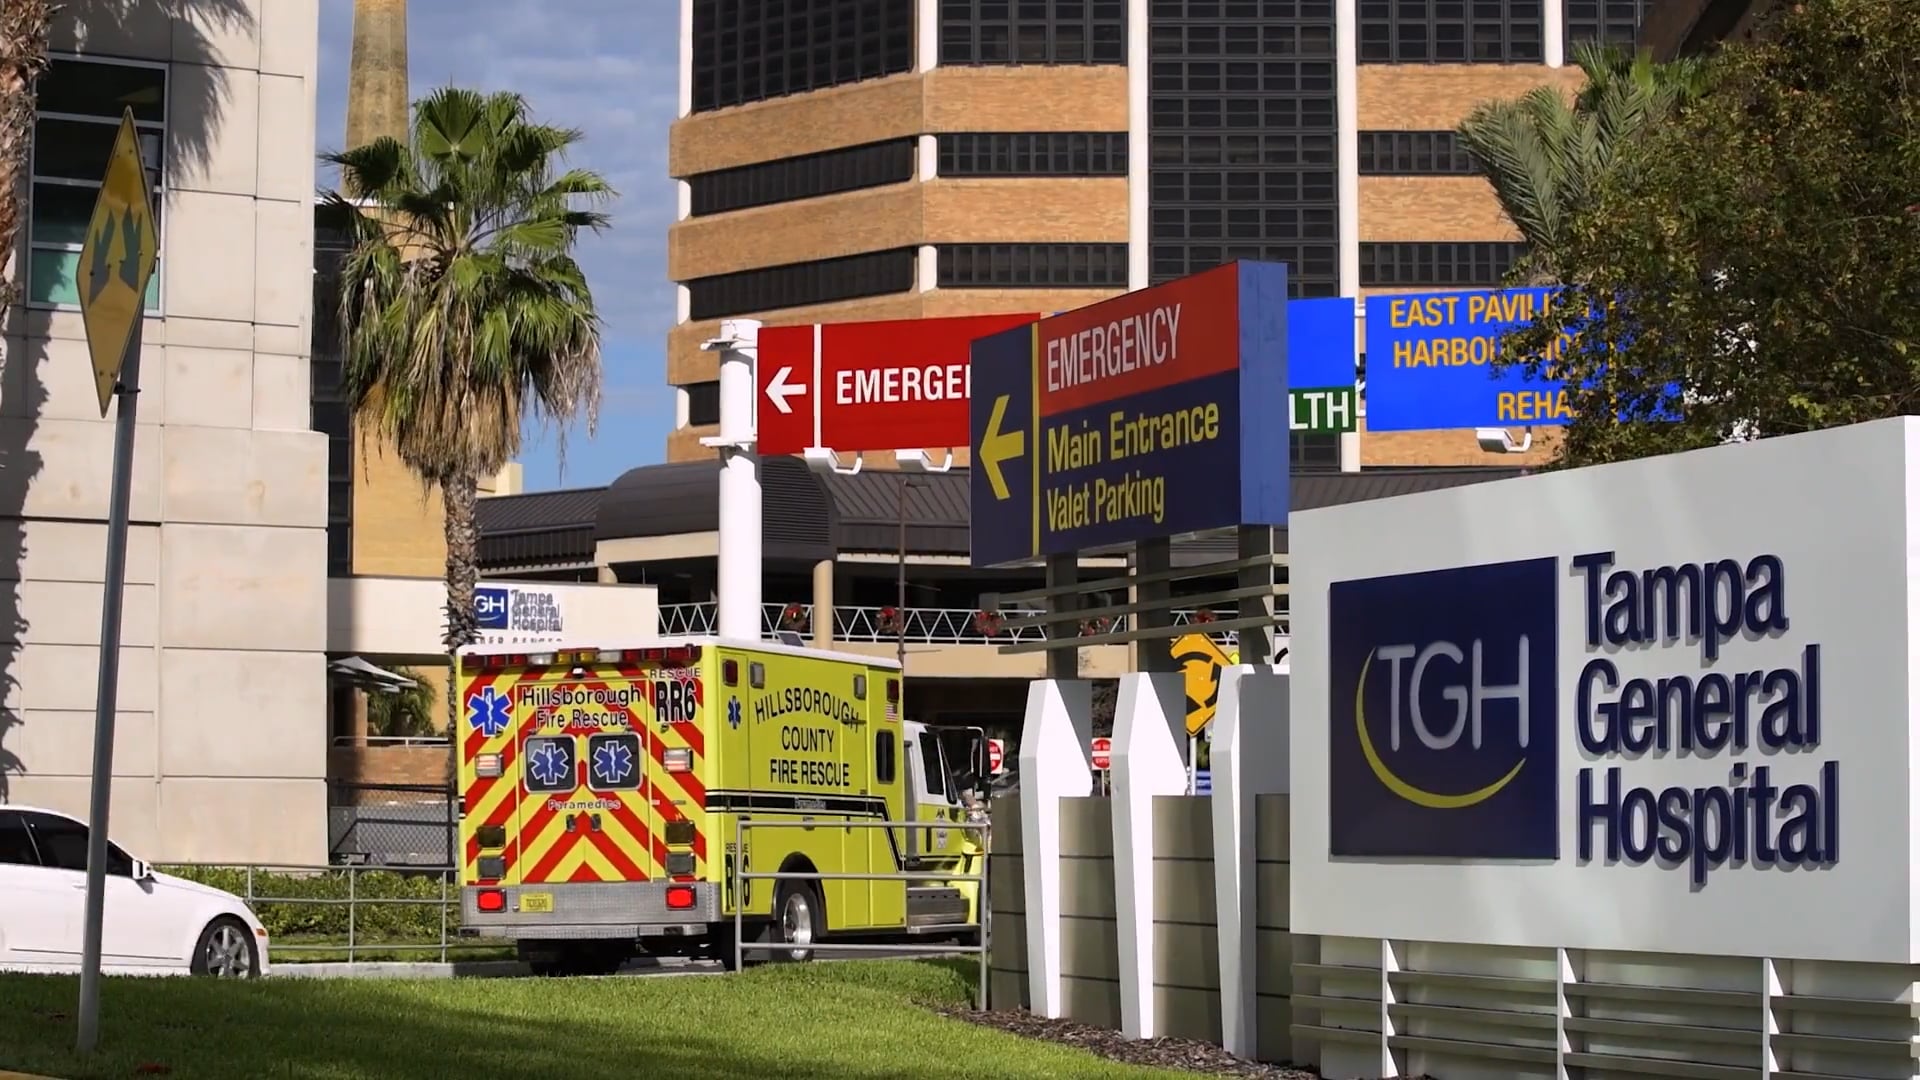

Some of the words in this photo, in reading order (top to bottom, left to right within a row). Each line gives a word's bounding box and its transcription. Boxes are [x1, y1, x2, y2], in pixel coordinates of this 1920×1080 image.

[1390, 297, 1459, 328] EAST
[1047, 303, 1183, 394] EMERGENCY
[1498, 390, 1583, 421] REHA
[1048, 417, 1102, 476] Main
[1109, 402, 1221, 459] Entrance
[1048, 484, 1091, 533] Valet
[1094, 472, 1165, 526] Parking
[1573, 551, 1791, 662] Tampa
[649, 667, 702, 679] RESCUE
[1377, 633, 1531, 753] TGH
[522, 685, 641, 708] Hillsborough
[535, 709, 566, 729] Fire
[571, 708, 629, 728] Rescue
[655, 679, 697, 723] RR6
[754, 687, 860, 734] HILLSBOROUGH
[1577, 644, 1822, 756] General
[781, 726, 835, 752] COUNTY
[770, 758, 799, 785] FIRE
[801, 760, 851, 787] RESCUE
[547, 798, 622, 812] Paramedics
[1578, 760, 1840, 886] Hospital
